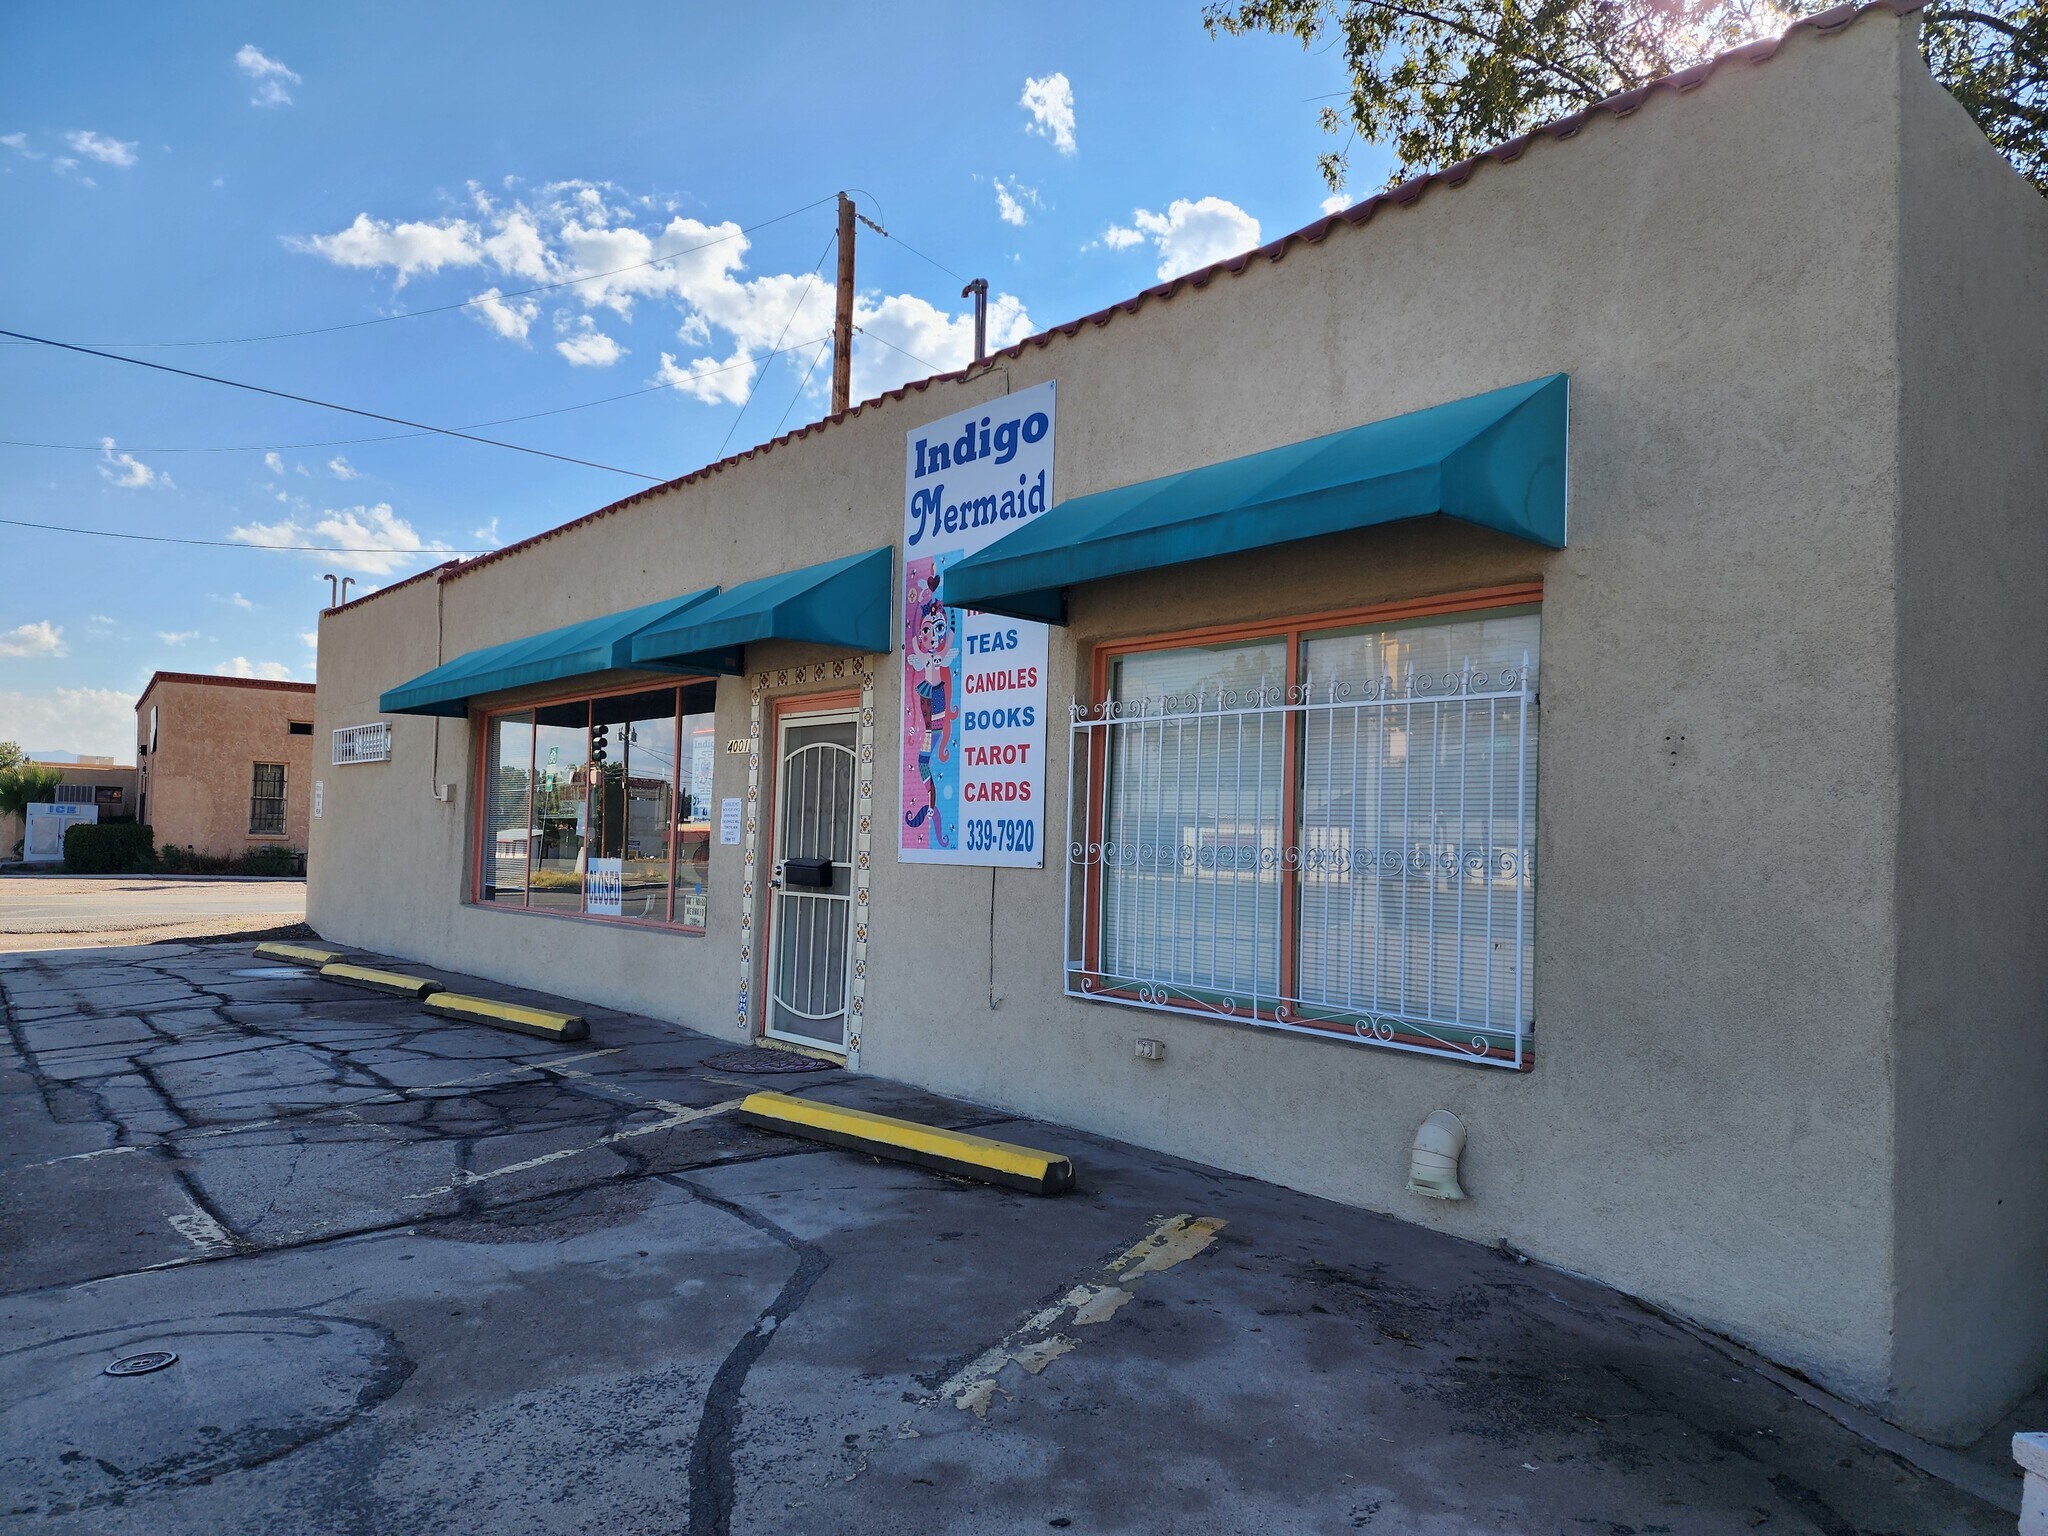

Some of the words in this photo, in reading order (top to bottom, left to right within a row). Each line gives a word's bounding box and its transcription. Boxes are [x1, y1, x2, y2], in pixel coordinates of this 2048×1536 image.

[914, 412, 1049, 479] Indigo
[908, 469, 1046, 546] Mermaid
[966, 629, 1018, 655] TEAS
[965, 667, 1038, 694] CANDLES
[964, 706, 1035, 731] BOOKS
[727, 740, 749, 752] 4001
[964, 744, 1031, 766] TAROT
[964, 781, 1031, 802] CARDS
[49, 805, 77, 813] ICE
[966, 819, 1035, 853] 339-7920
[588, 870, 620, 905] CLOSED
